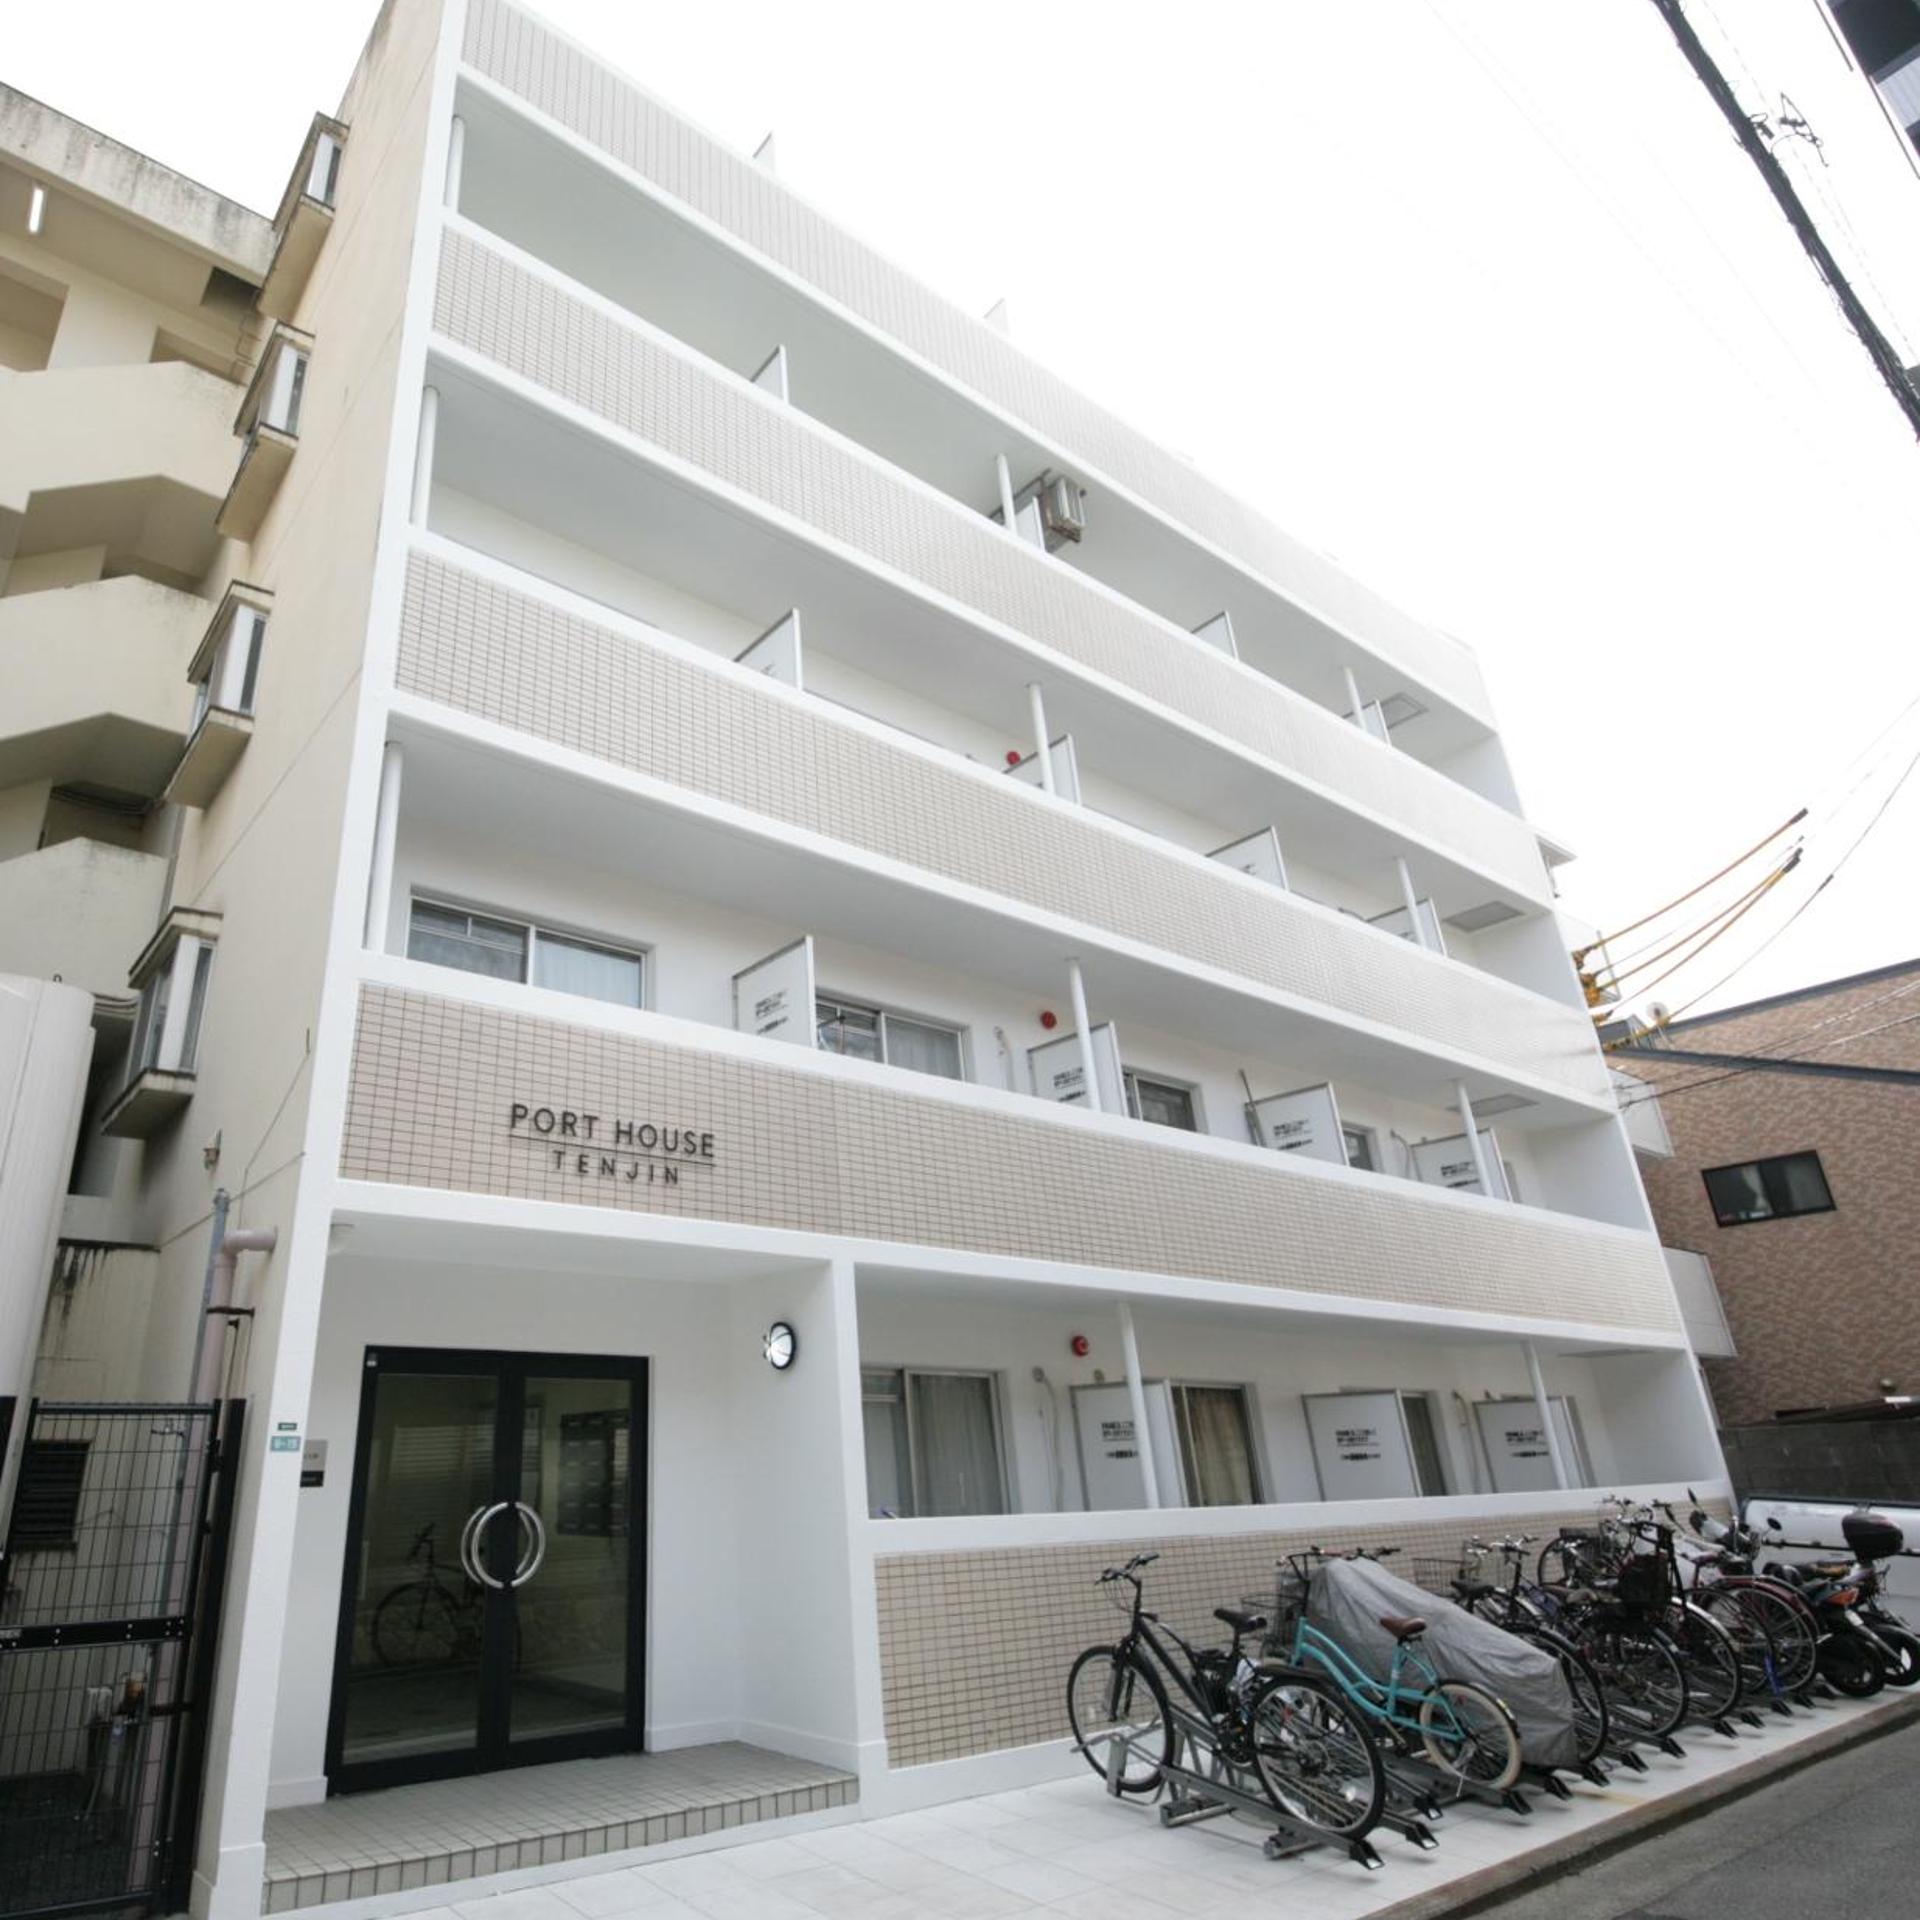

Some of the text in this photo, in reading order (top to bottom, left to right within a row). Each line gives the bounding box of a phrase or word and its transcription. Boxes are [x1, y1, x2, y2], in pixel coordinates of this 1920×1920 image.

[510, 1102, 715, 1159] PORT HOUSE
[553, 1149, 679, 1186] TENJIN
